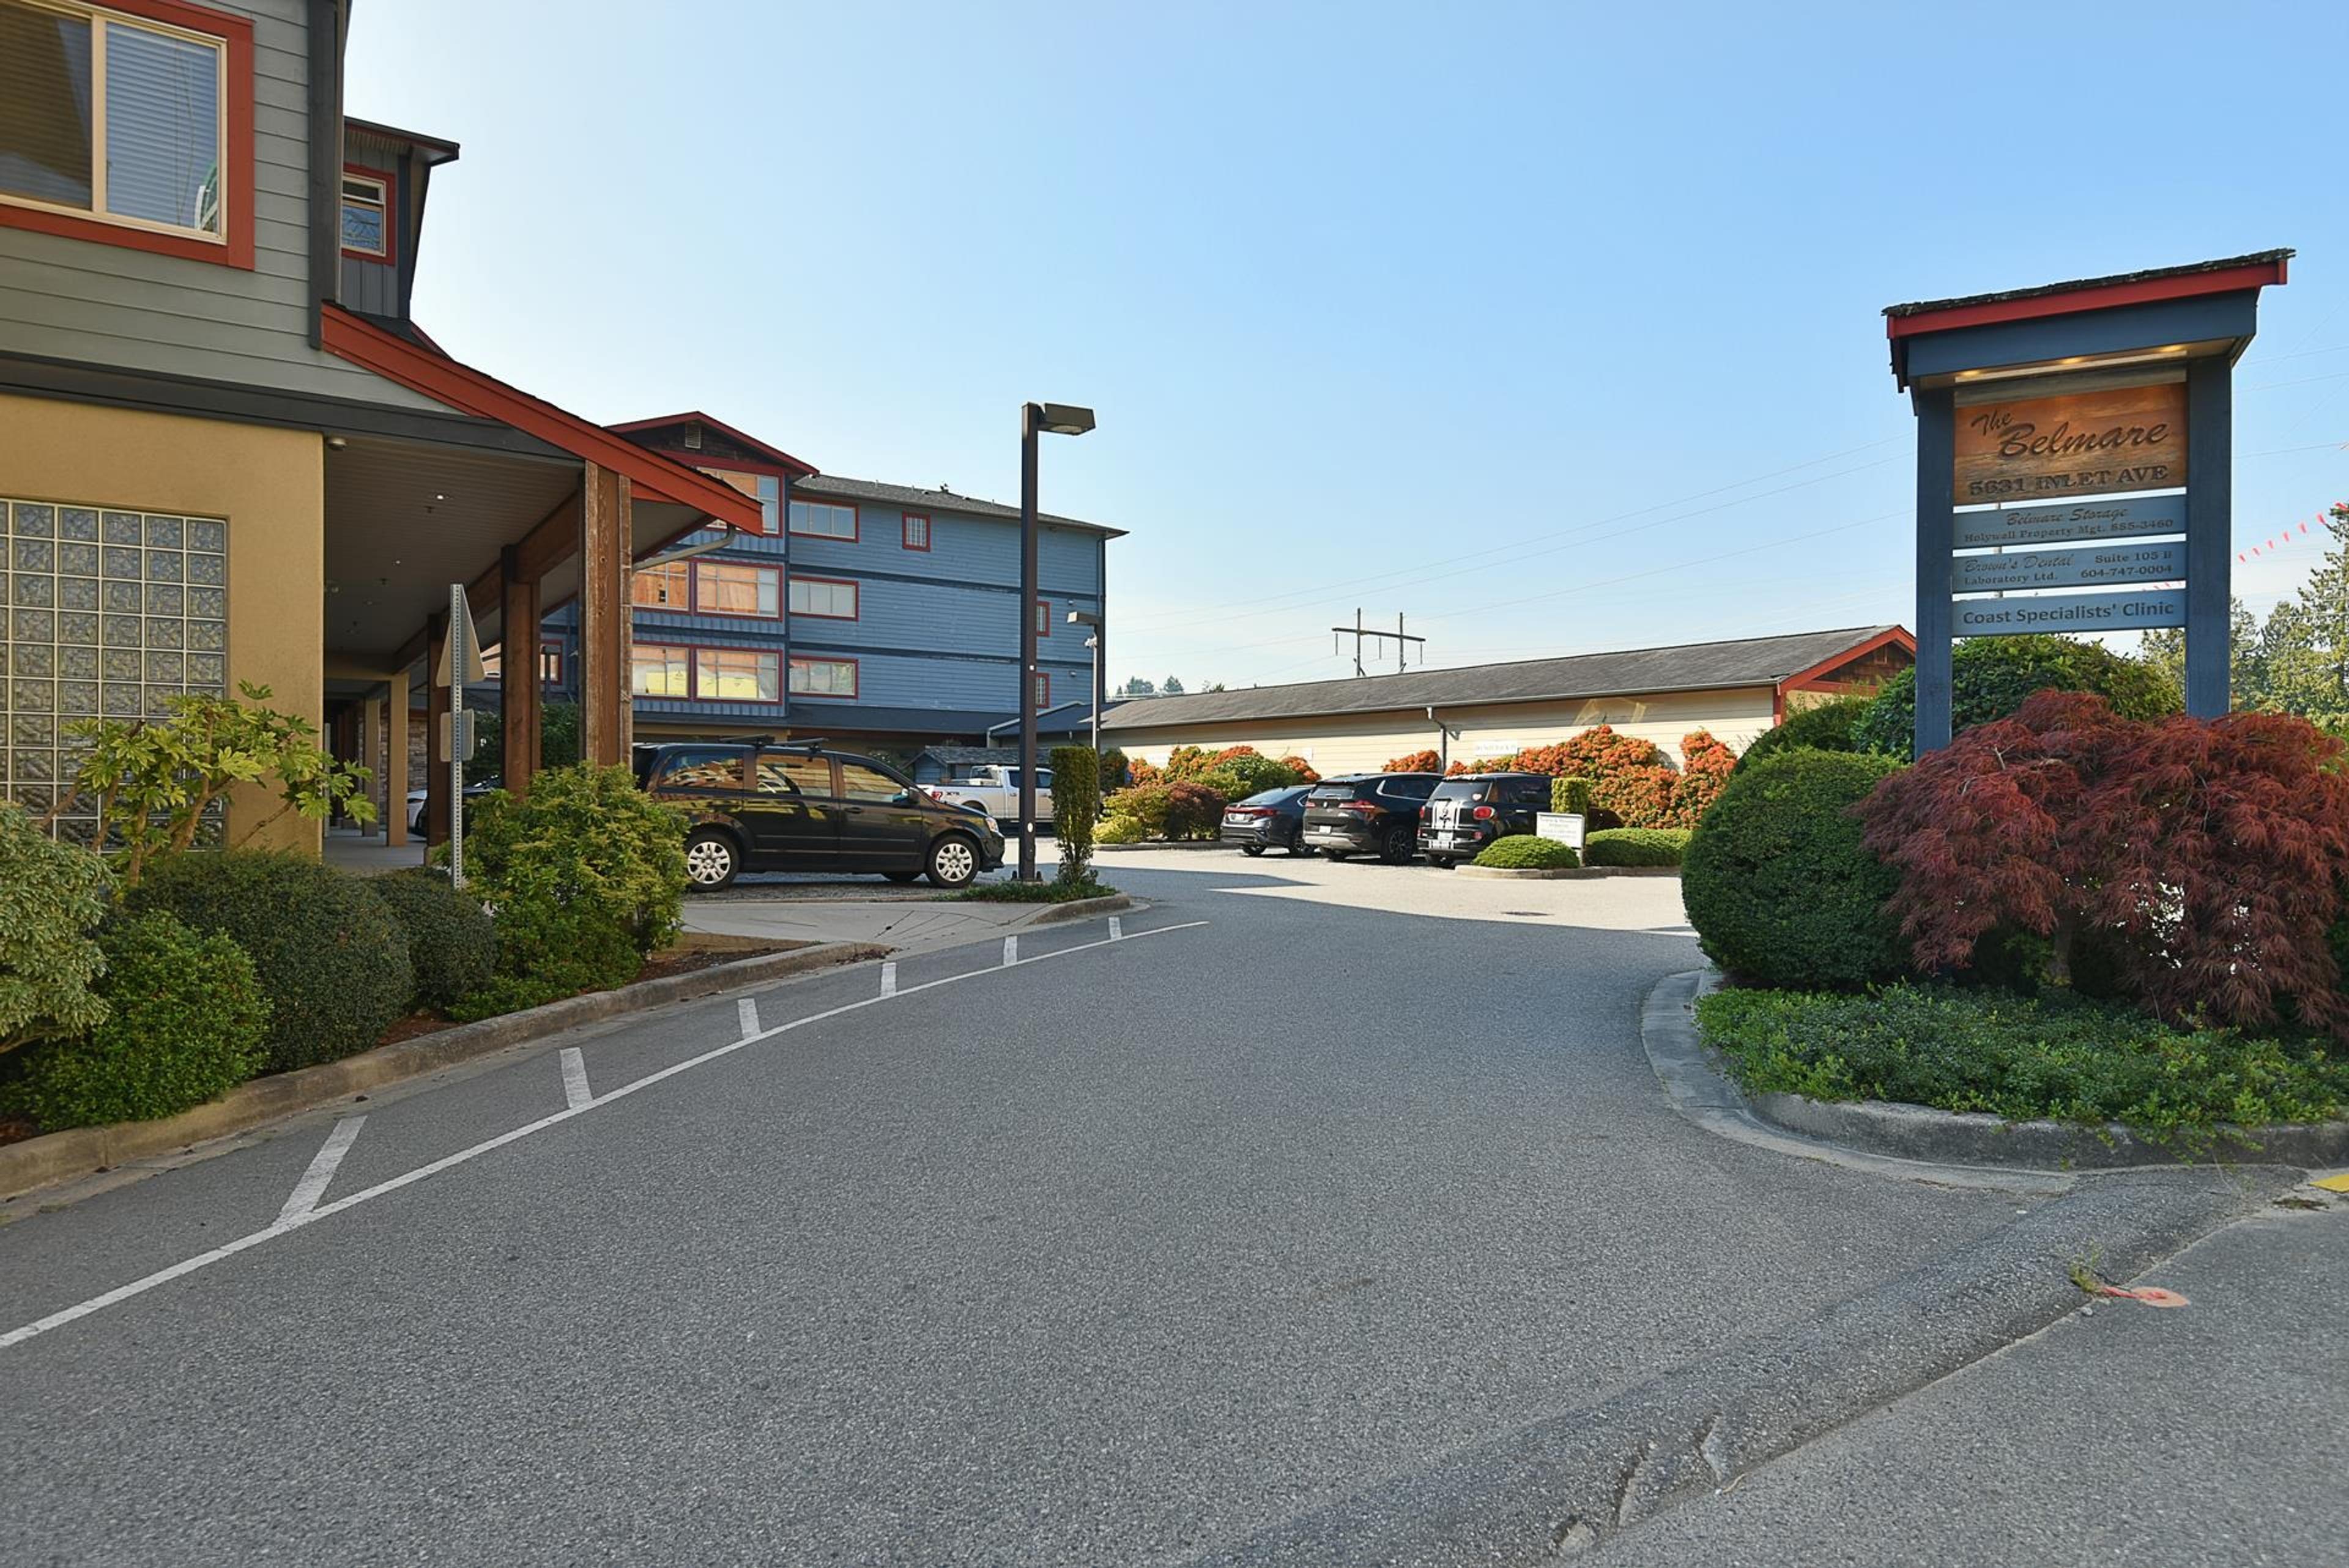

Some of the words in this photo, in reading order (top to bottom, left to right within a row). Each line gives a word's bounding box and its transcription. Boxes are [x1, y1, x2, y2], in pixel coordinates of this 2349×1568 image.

[1970, 409, 2012, 436] The
[1998, 422, 2169, 457] Belmare
[1970, 478, 2025, 495] 5631
[2036, 470, 2111, 490] INLET
[2116, 465, 2169, 483] AVE
[2069, 508, 2129, 522] Storage
[2019, 528, 2074, 539] Property
[1965, 557, 2018, 572] Brown's
[2024, 553, 2075, 569] Dental
[2095, 554, 2129, 564] Suite
[2134, 551, 2159, 561] 105
[1965, 574, 2029, 586] Laboratory
[2034, 572, 2058, 582] Ltd.
[2080, 564, 2173, 579] 604-747-0004
[1963, 610, 2011, 624] Coast
[2016, 604, 2117, 624] Specialists'
[2123, 602, 2174, 617] Clinic
